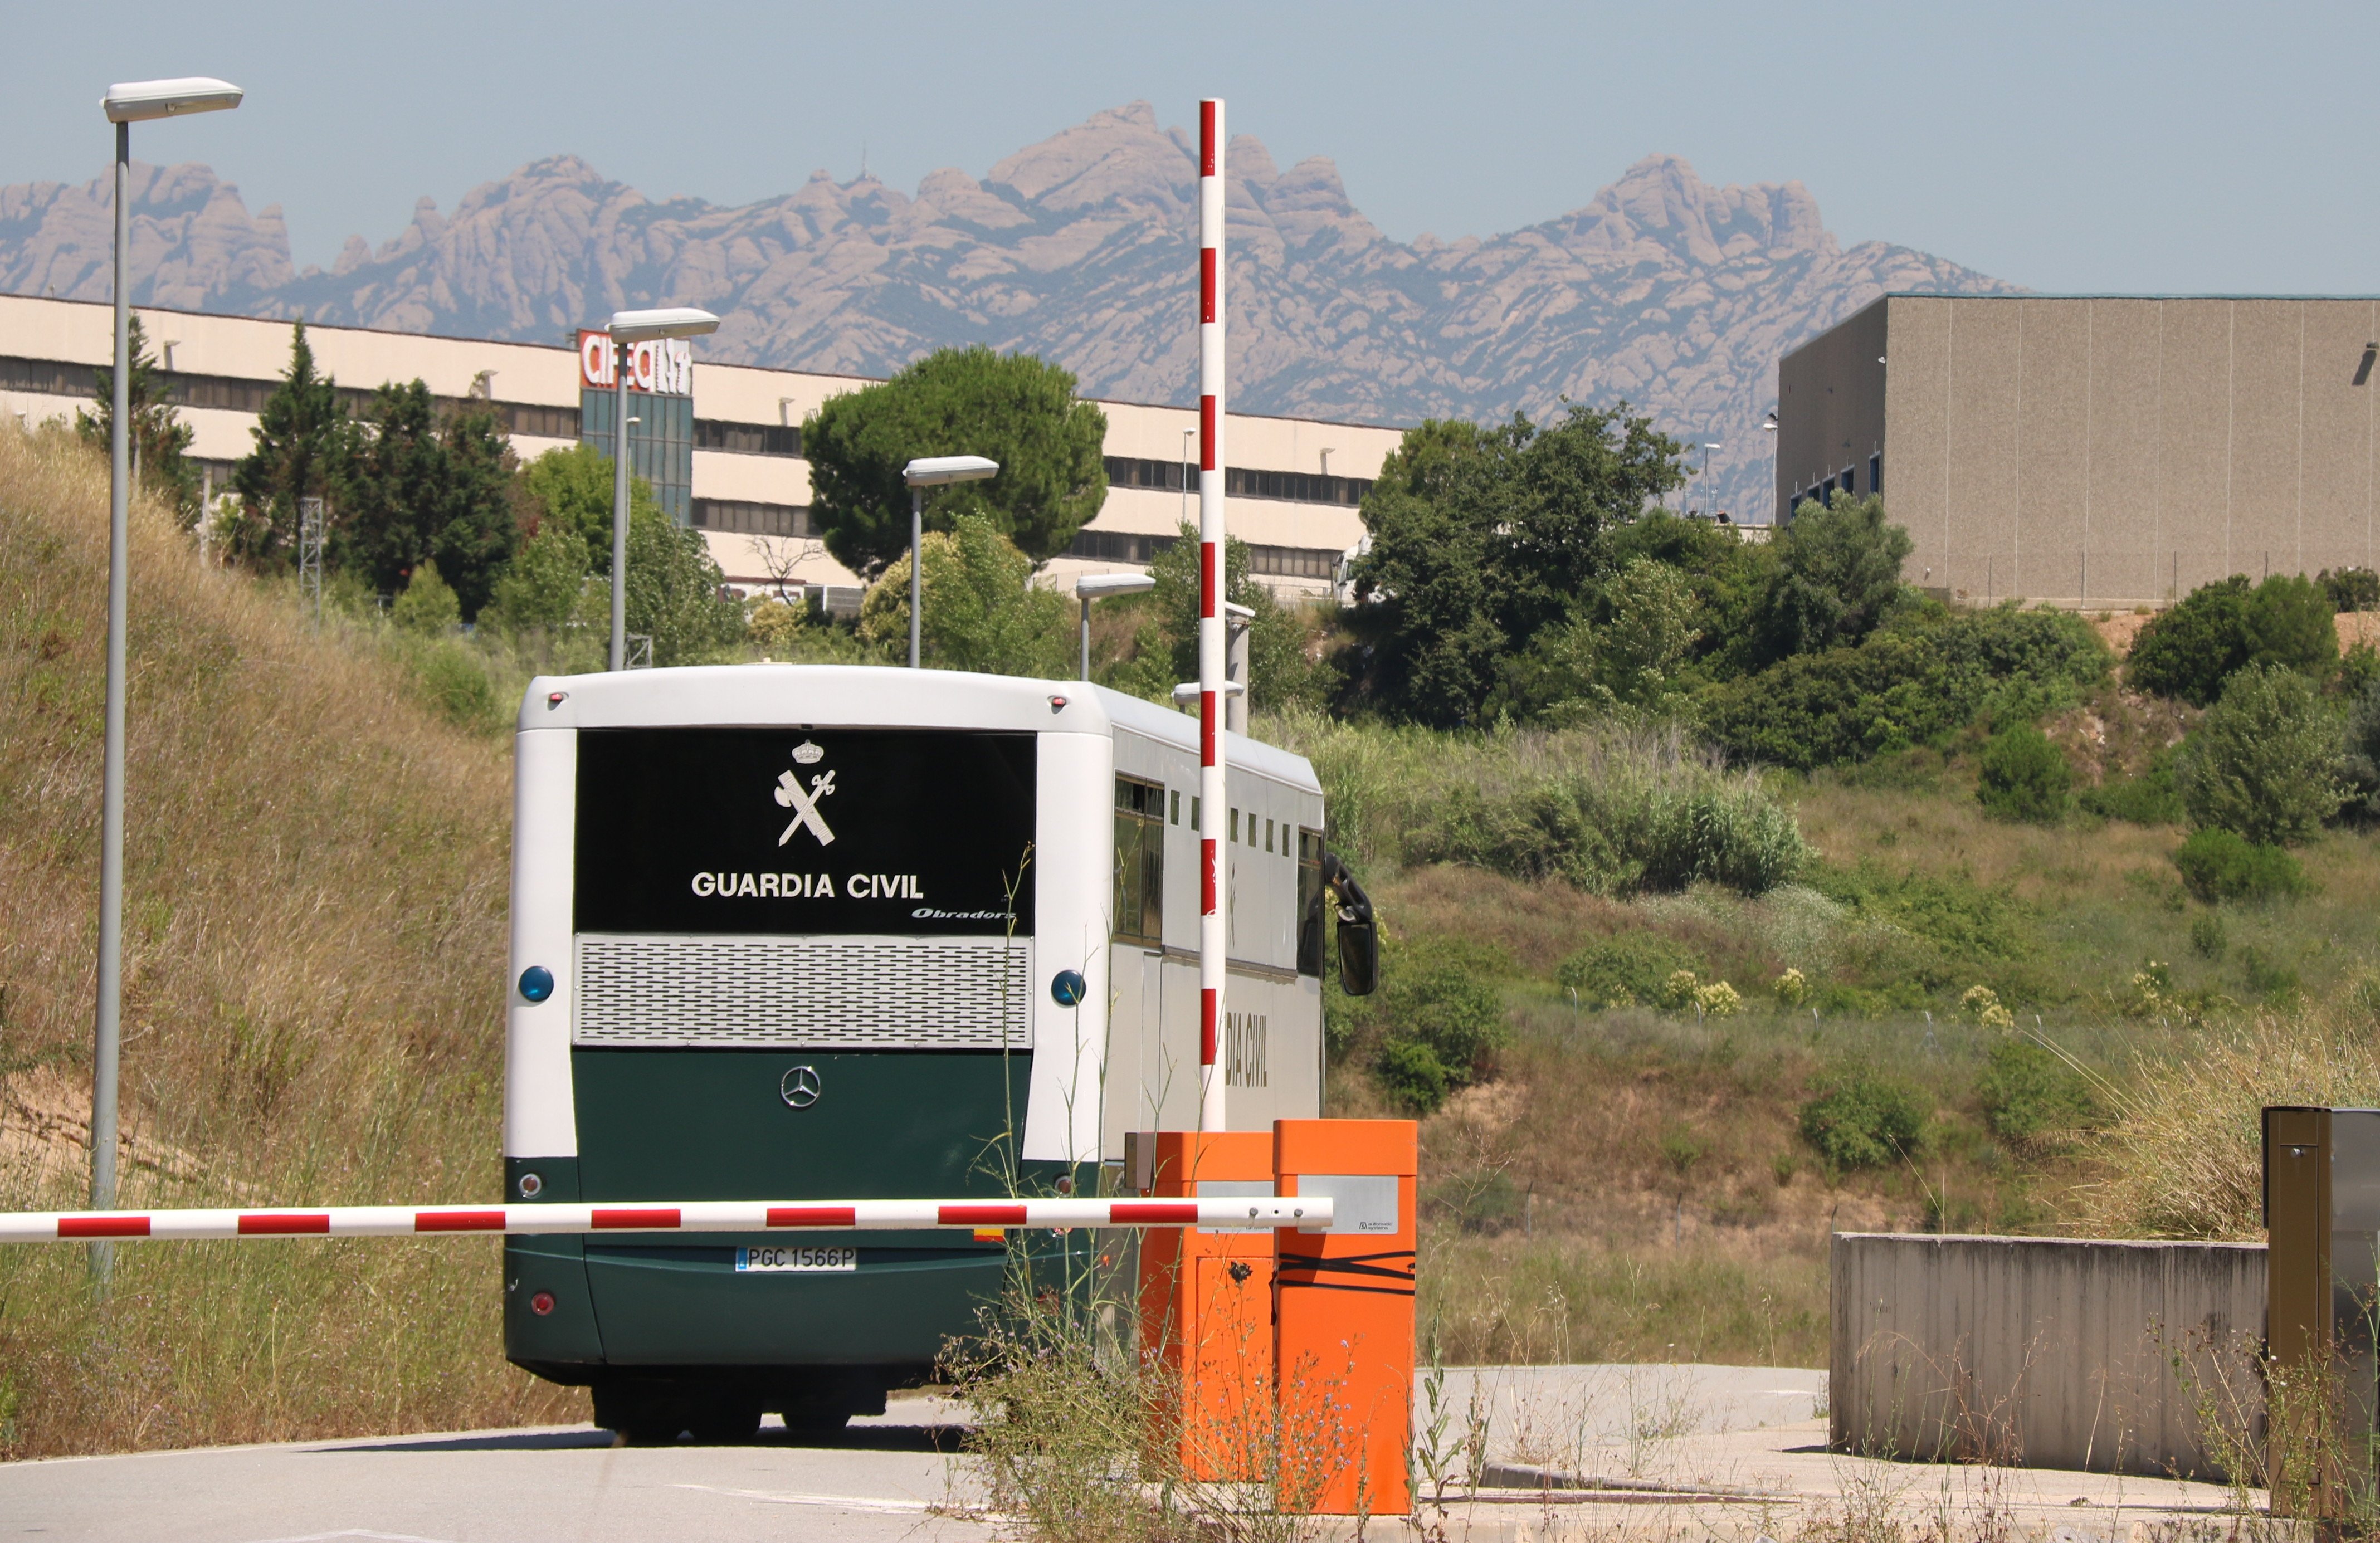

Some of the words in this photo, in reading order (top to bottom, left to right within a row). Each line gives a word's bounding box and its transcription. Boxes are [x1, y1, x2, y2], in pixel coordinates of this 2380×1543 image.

[691, 872, 835, 897] GUARDIA
[847, 873, 924, 899] CIVIL
[911, 907, 1017, 919] Obradors
[1245, 1012, 1267, 1088] CIVIL
[748, 1248, 786, 1268] PGC
